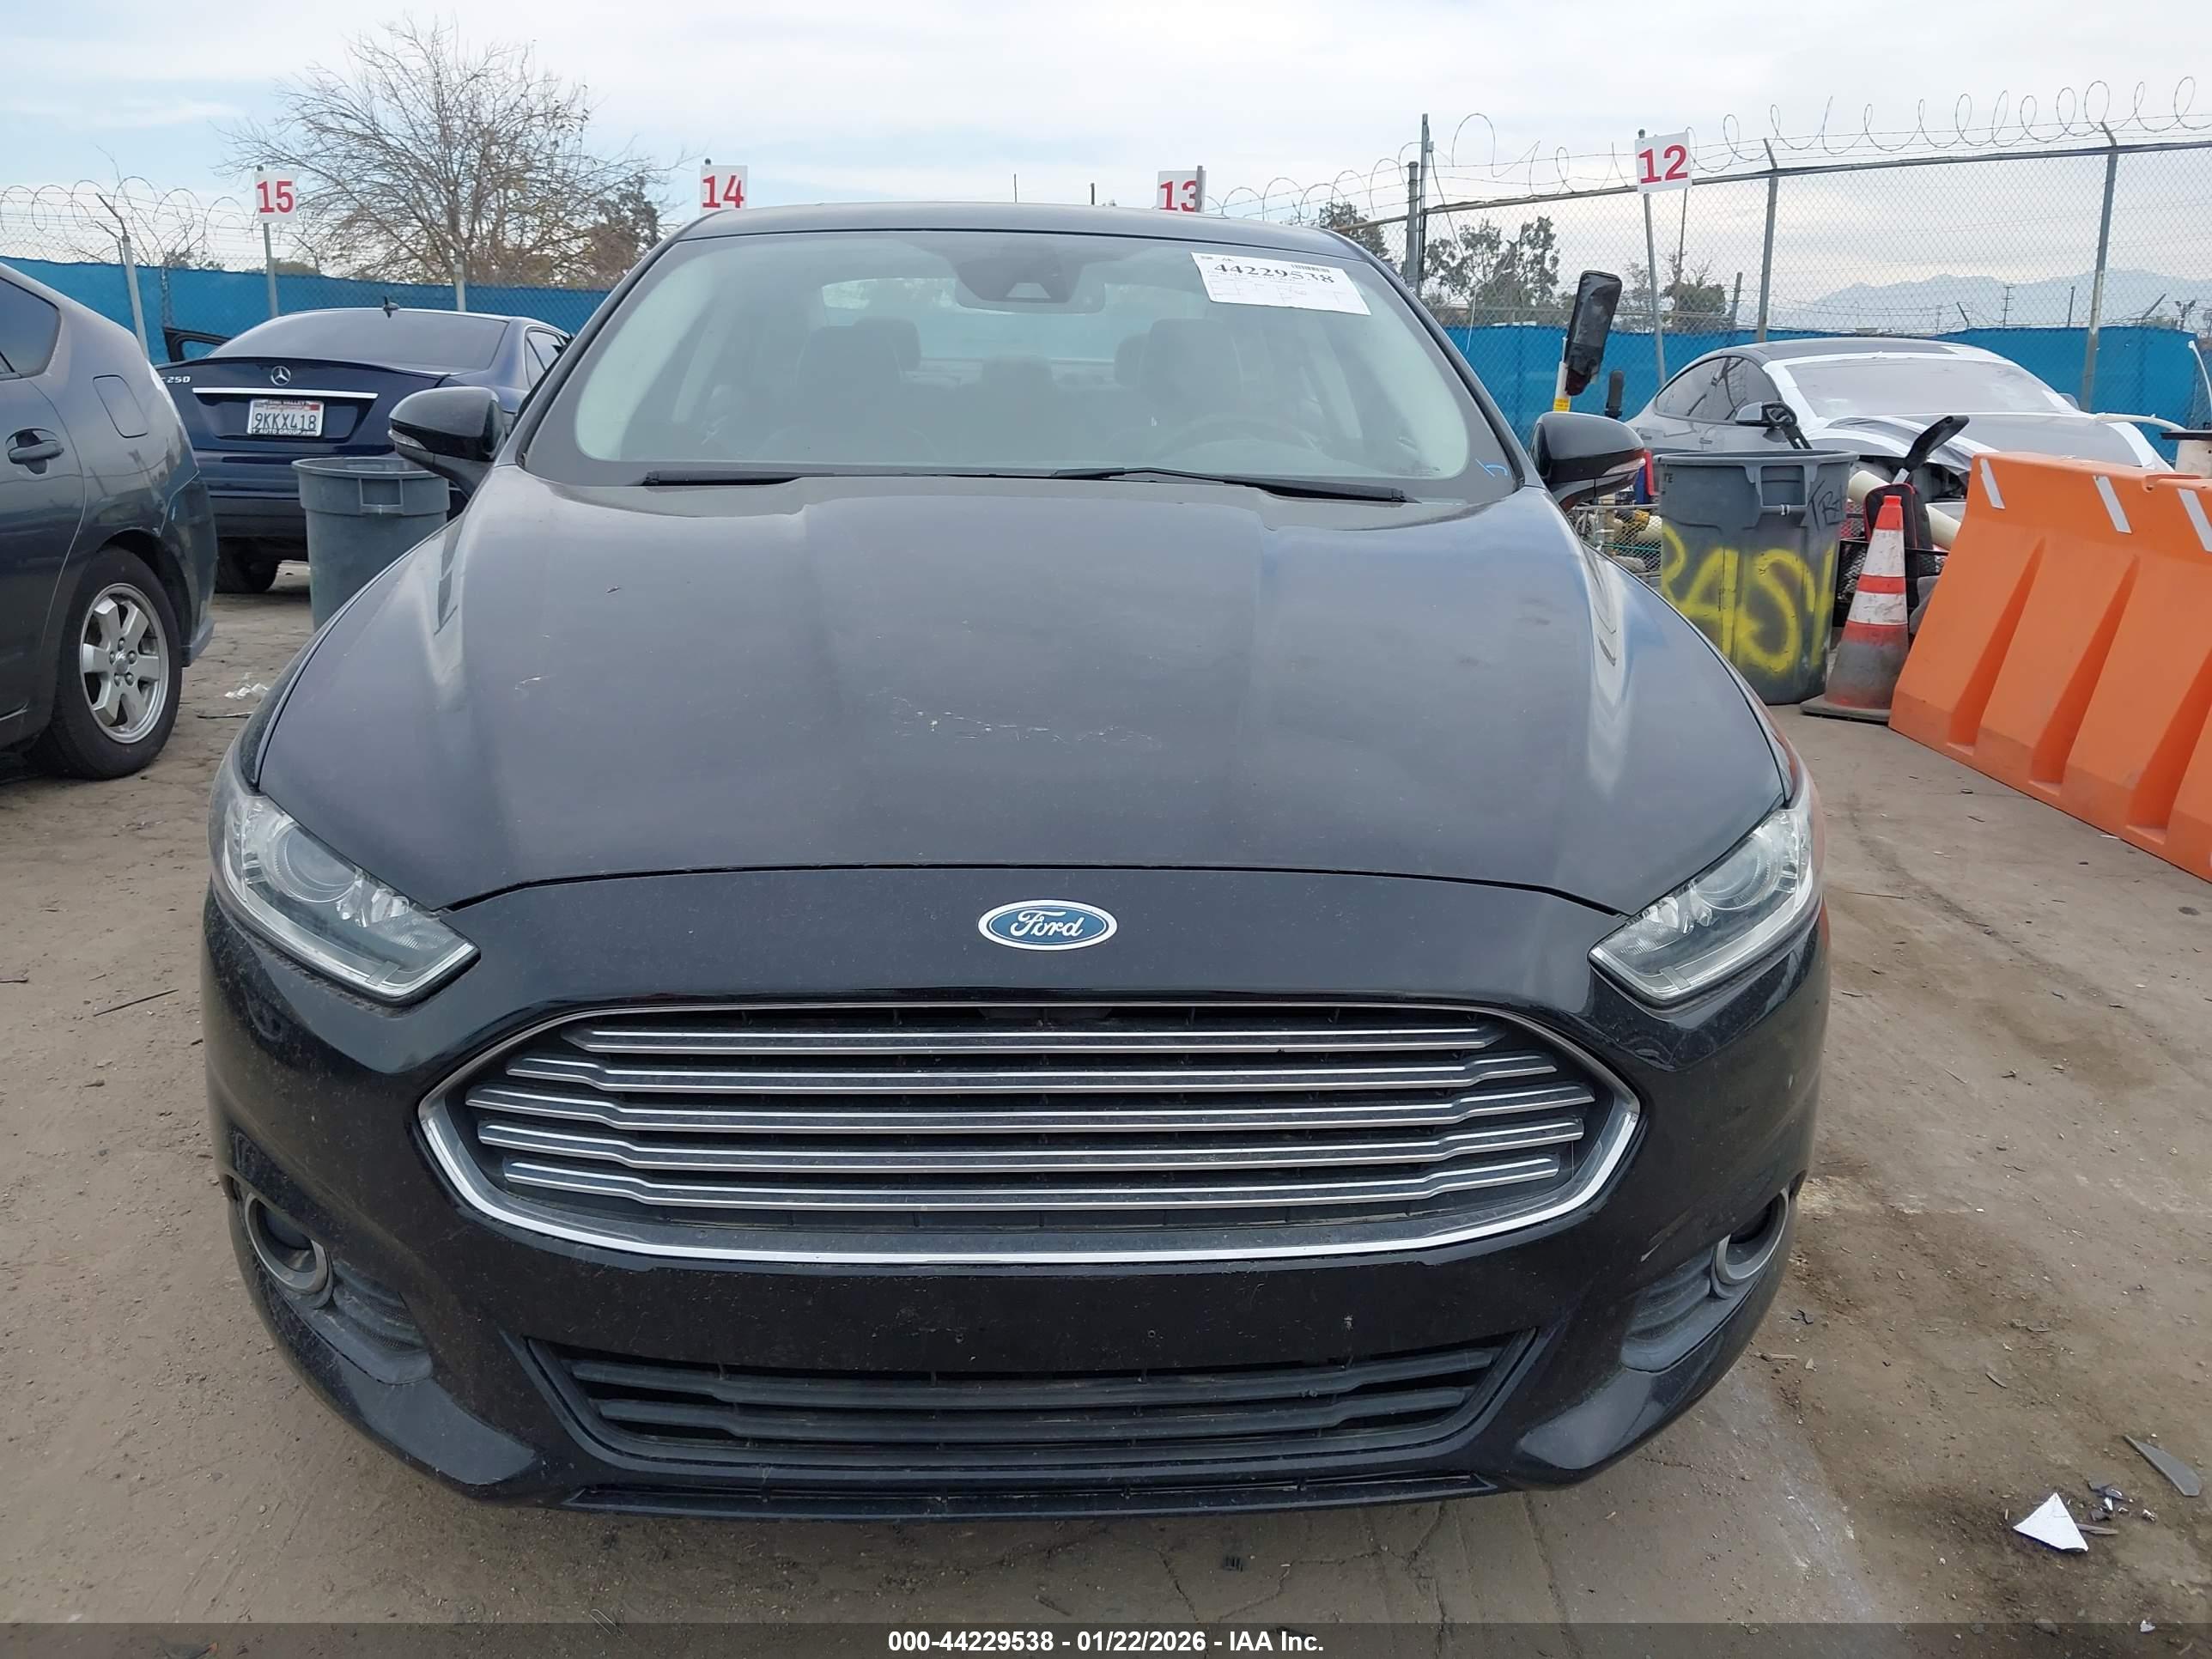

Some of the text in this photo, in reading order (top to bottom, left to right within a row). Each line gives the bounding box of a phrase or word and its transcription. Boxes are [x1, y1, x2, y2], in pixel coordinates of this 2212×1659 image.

[1638, 144, 1688, 184] 12
[257, 180, 294, 213] 15
[702, 175, 744, 209] 14
[1158, 179, 1197, 213] 13
[1213, 263, 1335, 284] 44229538
[253, 412, 317, 430] 9KKX418
[1010, 909, 1085, 937] Ford
